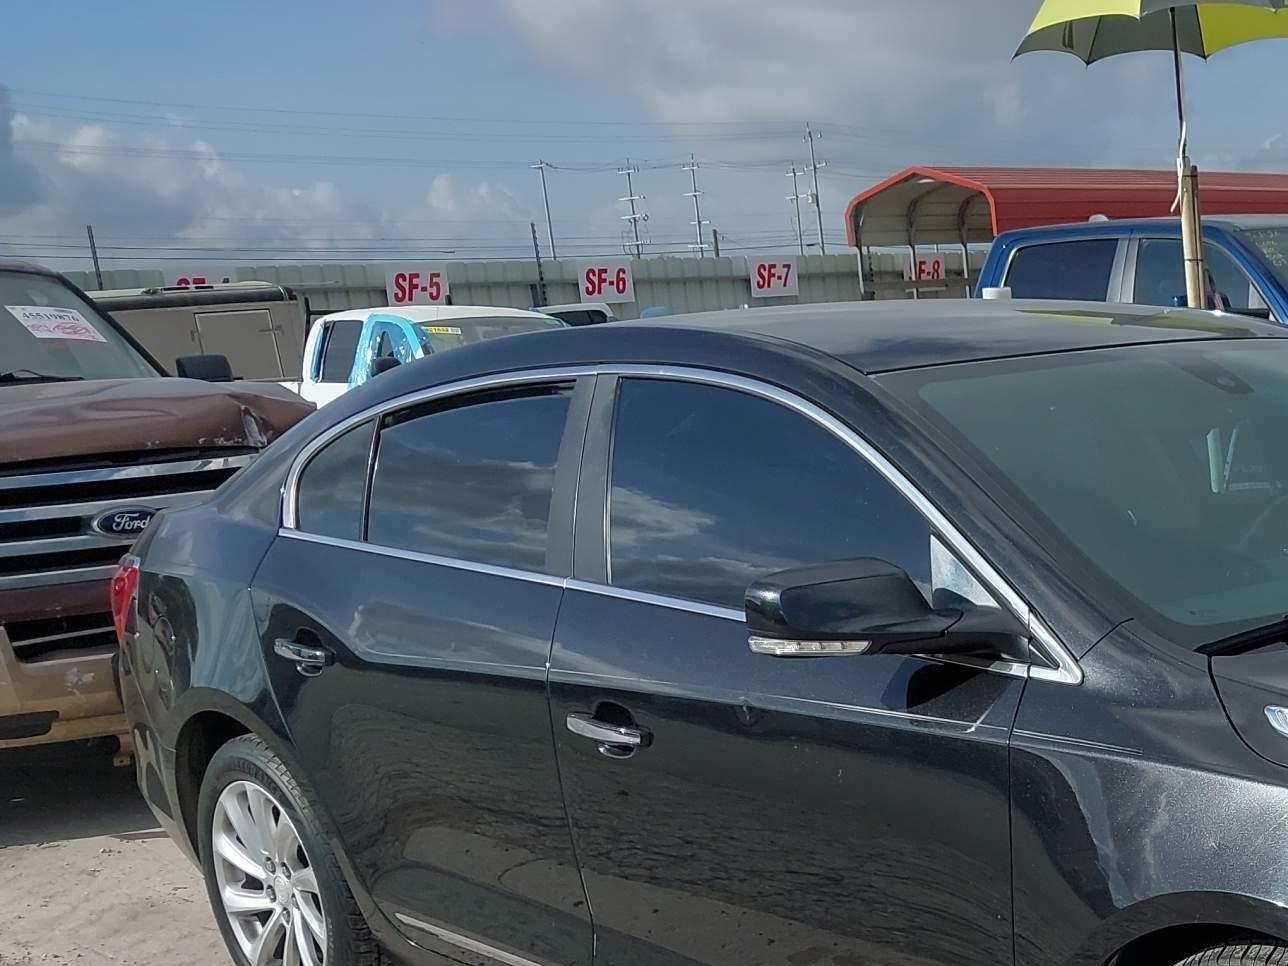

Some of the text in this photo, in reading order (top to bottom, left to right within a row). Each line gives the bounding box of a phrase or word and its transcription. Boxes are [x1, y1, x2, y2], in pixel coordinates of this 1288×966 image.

[585, 267, 627, 296] SF-6
[756, 263, 792, 289] SF-7
[912, 259, 941, 281] F-8
[393, 272, 441, 303] SF-5
[112, 512, 151, 532] Ford
